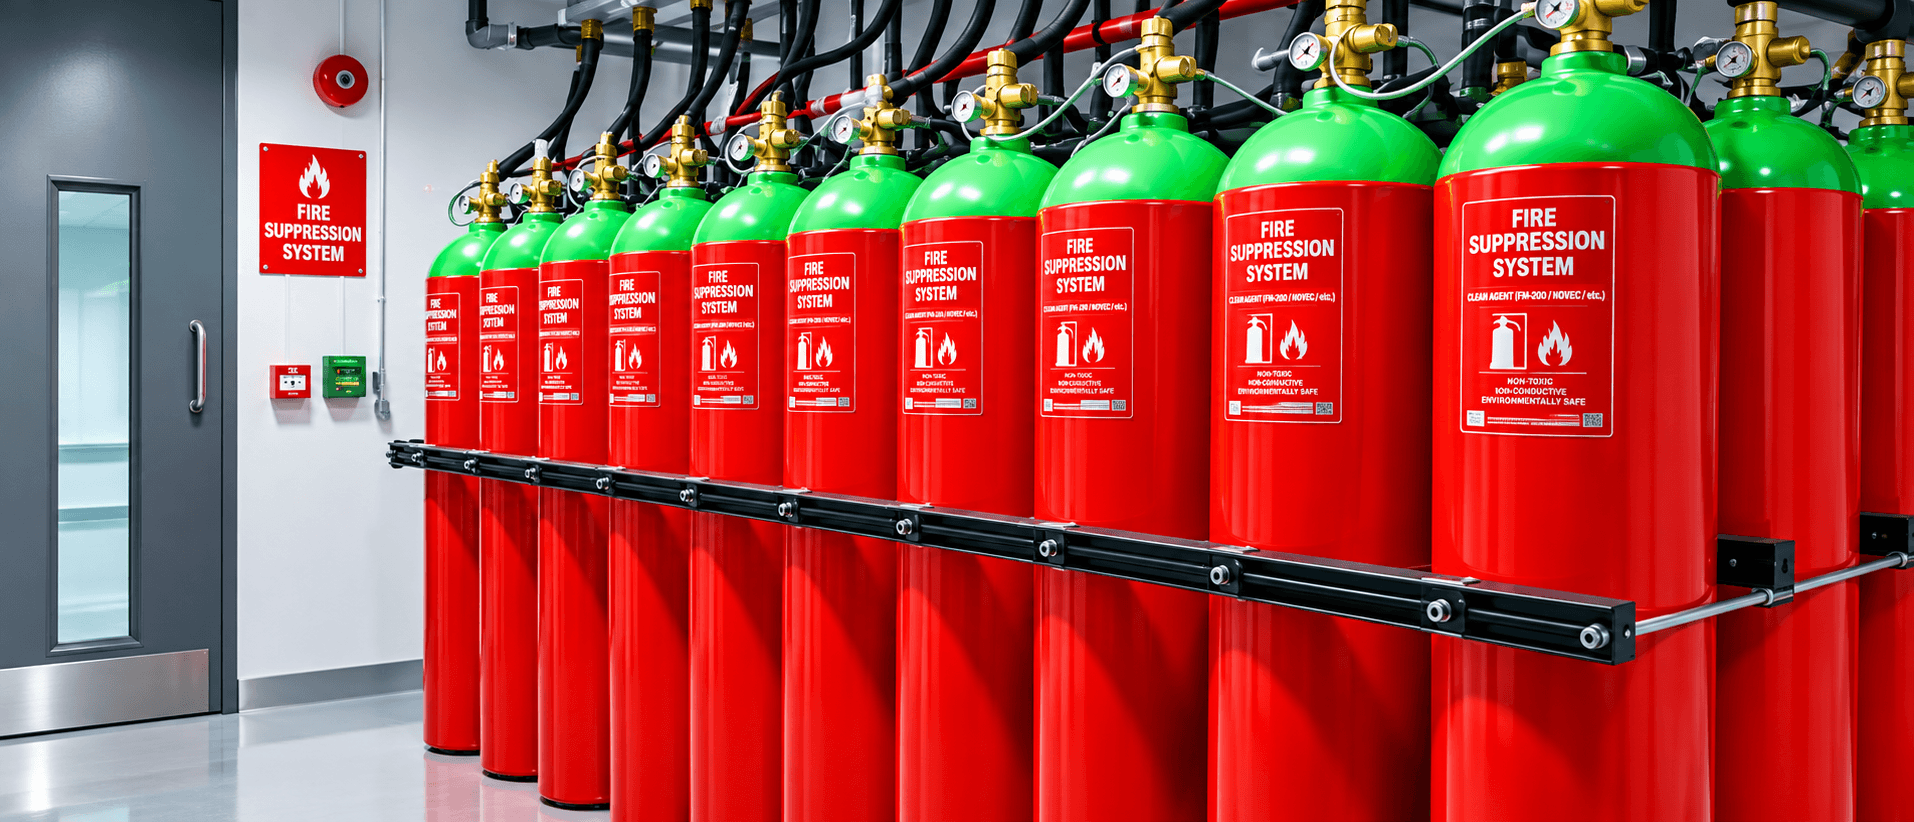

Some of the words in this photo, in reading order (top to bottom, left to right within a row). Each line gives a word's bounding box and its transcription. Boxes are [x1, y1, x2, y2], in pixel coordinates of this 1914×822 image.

[297, 203, 330, 221] FIRE
[1512, 207, 1557, 228] FIRE
[264, 222, 361, 242] SUPPRESSION
[1261, 219, 1294, 238] FIRE
[1067, 237, 1093, 254] FIRE
[1230, 239, 1334, 262] SUPPRESSION
[1469, 230, 1605, 254] SUPPRESSION
[283, 243, 344, 262] SYSTEM
[925, 250, 947, 266] FIRE
[804, 261, 824, 275] FIRE
[1044, 255, 1126, 275] SUPPRESSION
[1246, 262, 1308, 283] SYSTEM
[1492, 256, 1574, 278] SYSTEM
[708, 270, 728, 283] FIRE
[906, 267, 976, 284] SUPPRESSION
[790, 276, 850, 293] SUPPRESSION
[1056, 276, 1105, 294] SYSTEM
[797, 294, 833, 309] SYSTEM
[915, 285, 957, 302] SYSTEM
[1489, 292, 1514, 301] AGENT
[1553, 290, 1581, 300] NOVEC
[1587, 290, 1606, 301] etc.)
[701, 300, 737, 314] SYSTEM
[1564, 398, 1586, 406] SAFE
